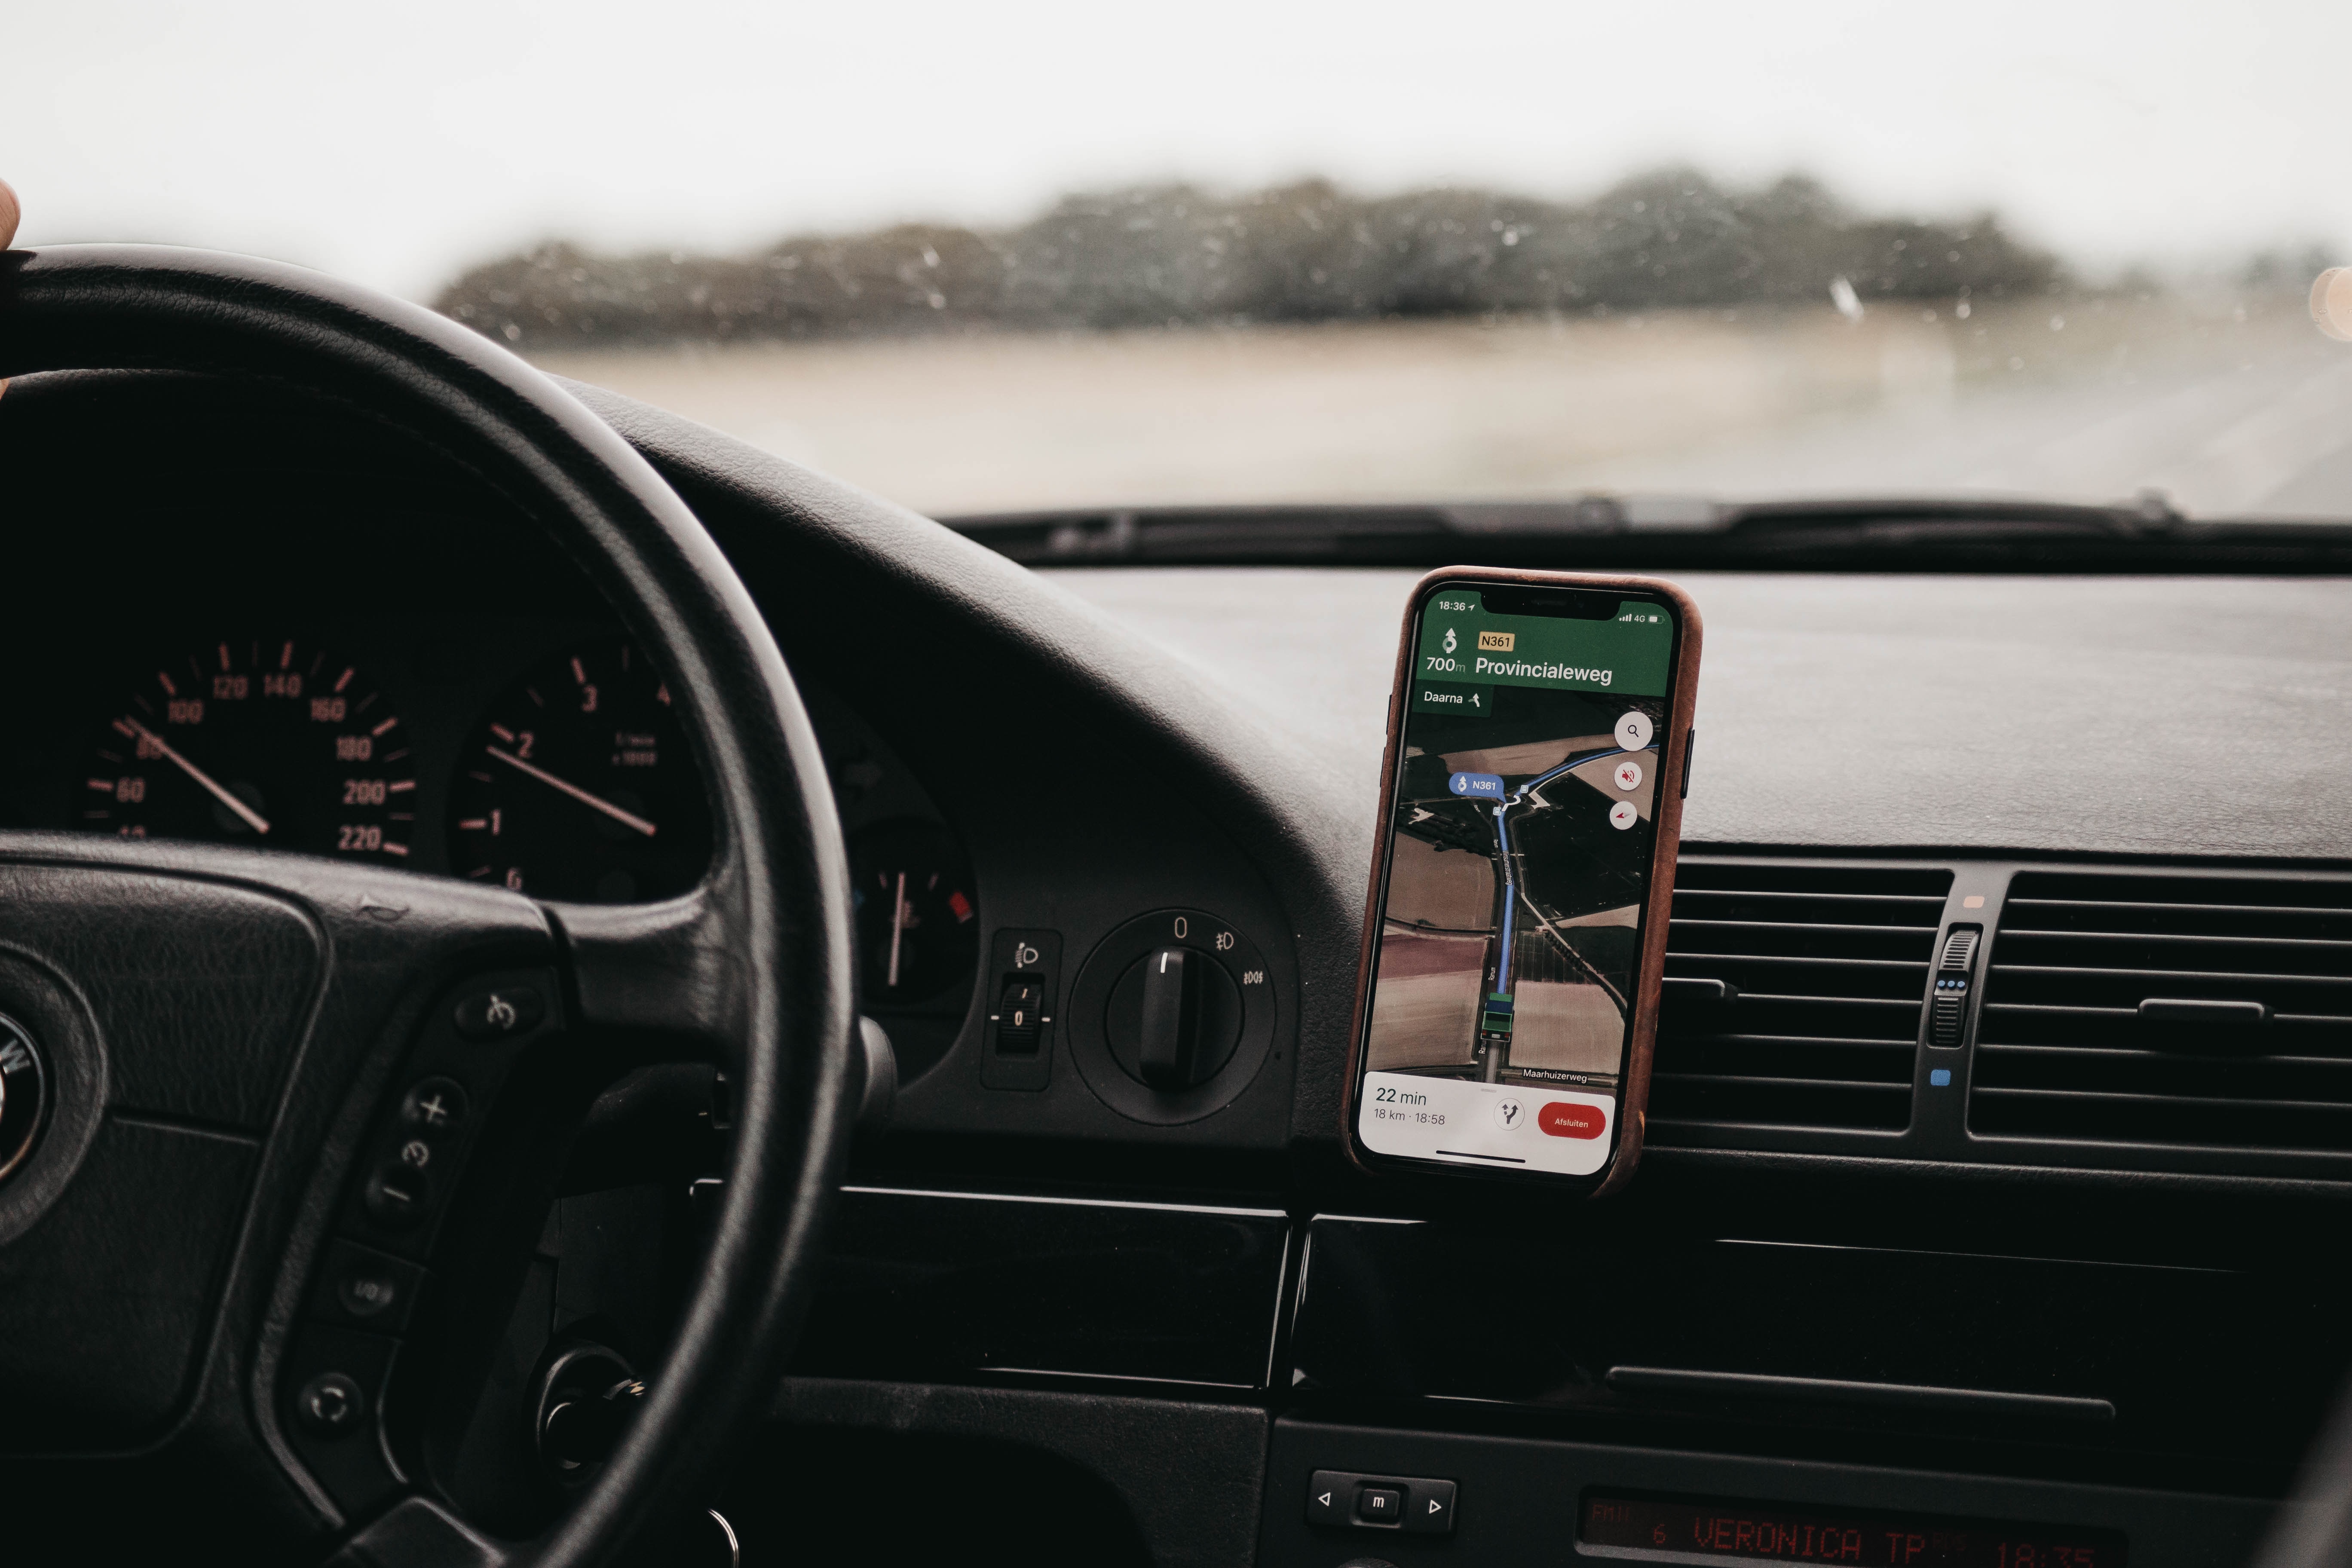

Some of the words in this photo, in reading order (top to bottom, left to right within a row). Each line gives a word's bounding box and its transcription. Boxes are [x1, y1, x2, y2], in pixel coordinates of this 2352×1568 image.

[1439, 601, 1466, 612] 18:36
[1634, 615, 1645, 623] 4G
[1481, 635, 1510, 648] N361
[1476, 657, 1612, 686] Provincialeweg
[214, 675, 248, 699] 120
[264, 672, 302, 698] 140
[582, 685, 597, 712] 3
[1424, 691, 1463, 704] Daarna
[518, 732, 534, 758] 2
[343, 779, 386, 805] 200
[1472, 780, 1496, 791] N361
[491, 809, 501, 835] 1
[338, 825, 383, 851] 220
[1523, 1069, 1588, 1083] Maarhuizerweg
[1376, 1087, 1396, 1103] 22
[1400, 1091, 1427, 1106] min
[1374, 1108, 1386, 1119] 18
[1389, 1110, 1406, 1121] km
[1415, 1112, 1445, 1125] 18:58
[1554, 1118, 1589, 1128] Afsluiten
[1373, 1496, 1384, 1508] m
[1653, 1524, 1667, 1545] 6
[1693, 1516, 1862, 1561] VERONICA
[1886, 1532, 1926, 1564] TP
